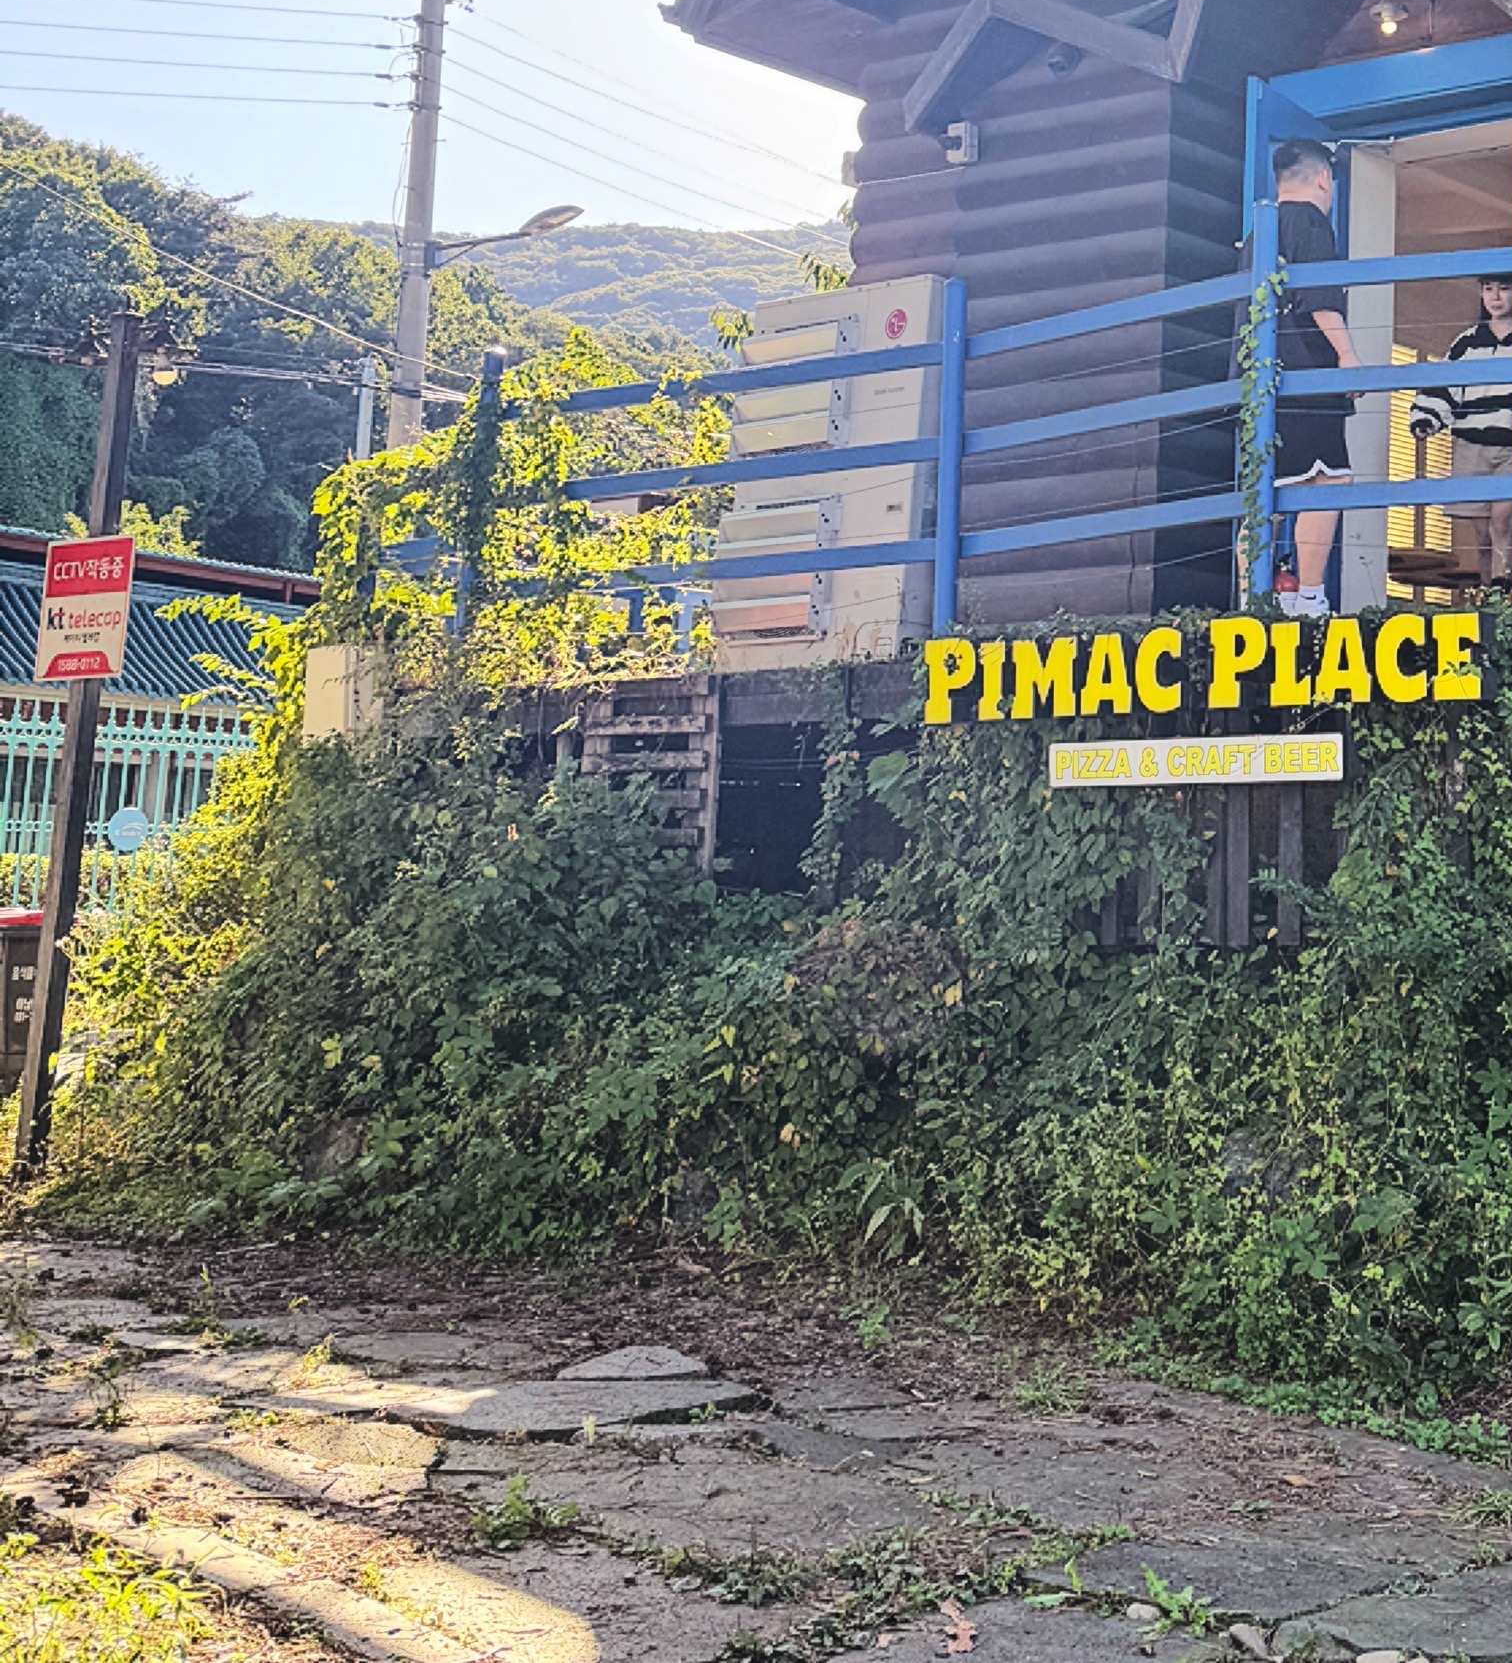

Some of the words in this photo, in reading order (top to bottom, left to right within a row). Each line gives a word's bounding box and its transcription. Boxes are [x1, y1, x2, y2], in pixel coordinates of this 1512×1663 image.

[47, 607, 66, 630] kt
[68, 609, 122, 630] telecop
[924, 628, 1183, 725] PIMAC
[1208, 612, 1483, 709] PLACE
[1056, 748, 1132, 779] PIZZA
[1139, 747, 1159, 777] &
[1167, 744, 1257, 776] CRAFT
[1264, 741, 1339, 773] BEER
